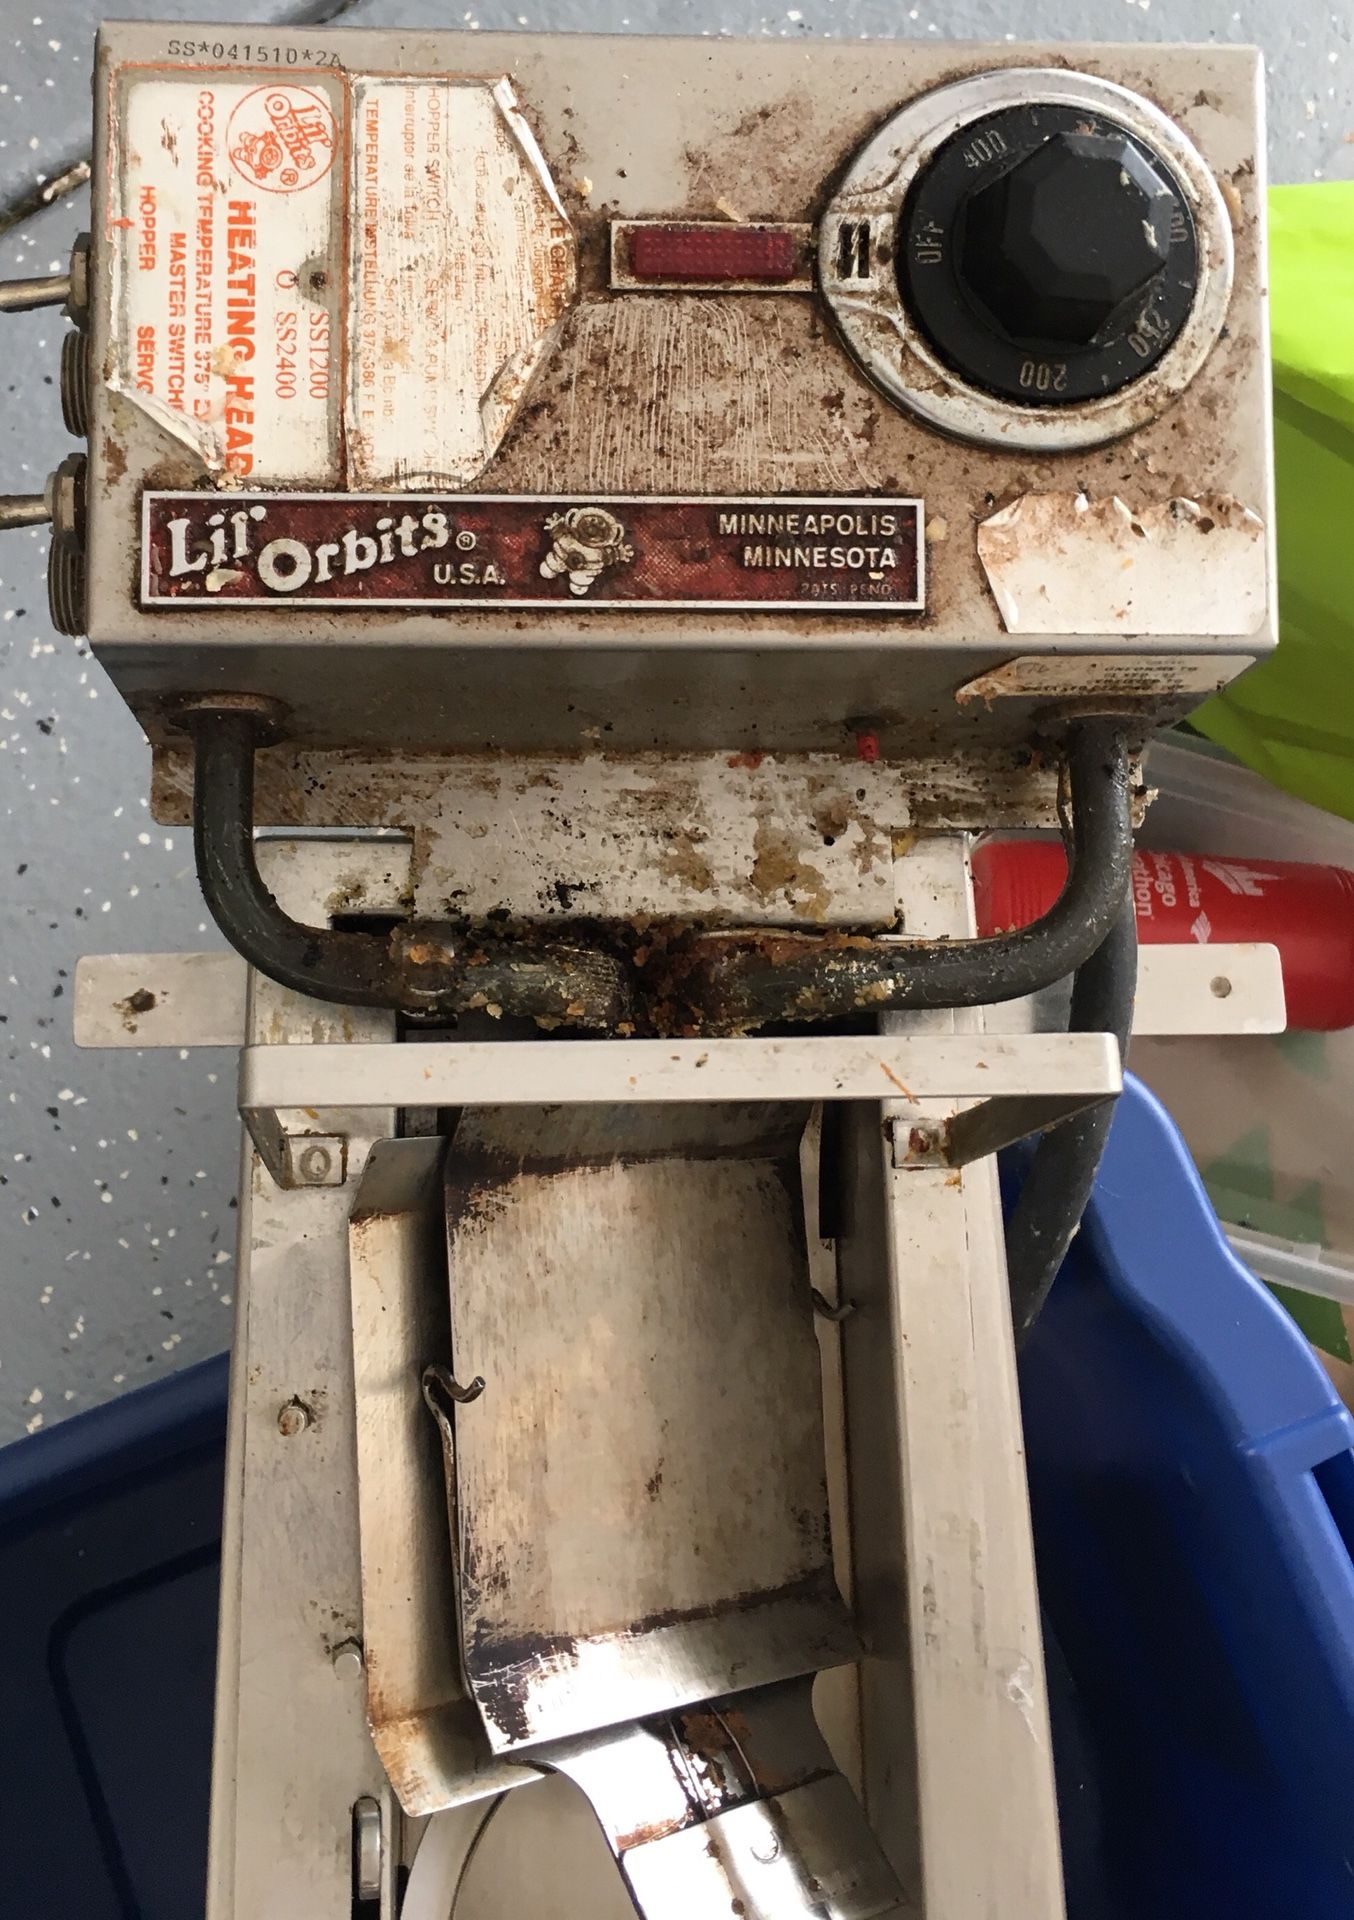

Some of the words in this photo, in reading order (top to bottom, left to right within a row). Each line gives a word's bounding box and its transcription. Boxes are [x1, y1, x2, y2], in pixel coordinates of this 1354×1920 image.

[196, 91, 214, 187] COOKING
[264, 94, 317, 171] Orbits
[364, 99, 379, 217] TEMPERATURE
[427, 87, 440, 153] HOPPER
[963, 130, 1007, 168] 400
[138, 186, 156, 271] HOPPER
[426, 159, 440, 221] SWITCH
[169, 232, 187, 317] MASTER
[194, 193, 213, 345] TEMPERATURE
[226, 201, 256, 361] HEATING
[915, 218, 944, 265] OFF
[276, 311, 297, 399] SS2400
[309, 312, 329, 399] SS1200
[1019, 360, 1067, 391] 200
[224, 376, 254, 476] HEAD
[167, 504, 267, 577] Lil'
[257, 510, 451, 593] Orbits
[718, 512, 898, 538] MINNEAPOLIS
[742, 545, 898, 570] MINNESOTA
[433, 563, 507, 587] U.S.A.
